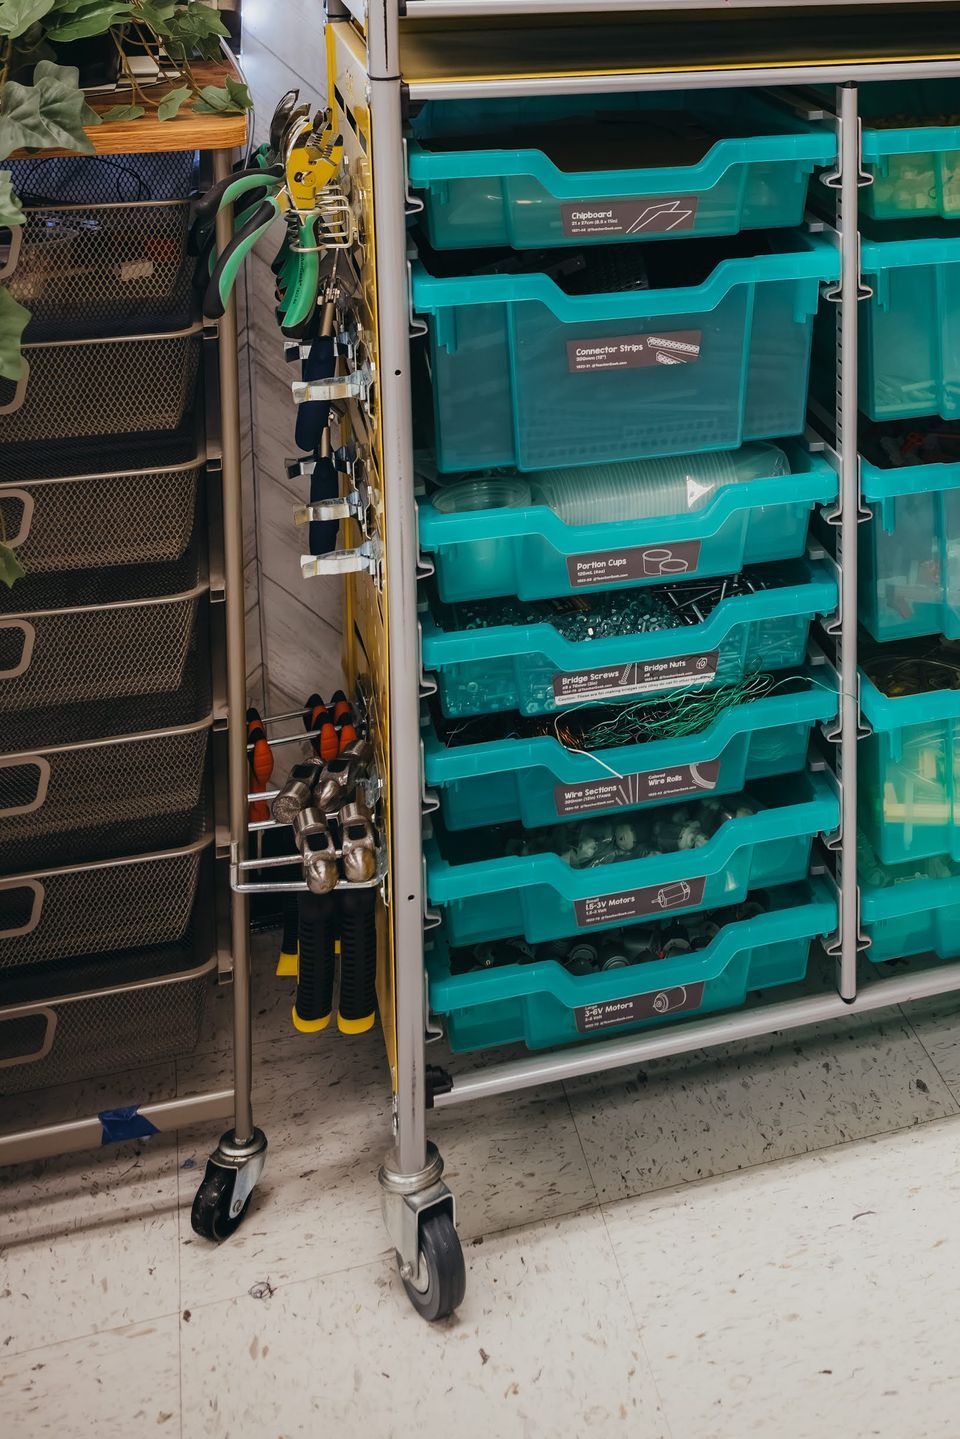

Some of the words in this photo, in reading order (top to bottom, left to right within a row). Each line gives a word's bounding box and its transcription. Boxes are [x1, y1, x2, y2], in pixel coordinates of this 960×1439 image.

[572, 210, 612, 220] Chipboard
[576, 346, 617, 356] Connector
[620, 344, 643, 352] Strips
[577, 561, 606, 571] Portion
[608, 559, 627, 567] Cups
[644, 663, 668, 672] Bridge
[562, 675, 588, 685] Bridge
[590, 671, 619, 680] Screws
[648, 778, 665, 787] Wire
[666, 775, 682, 783] Rolls
[565, 791, 583, 800] Wire
[584, 785, 617, 796] Sections
[608, 896, 635, 906] Motors
[605, 1001, 633, 1012] Motors
